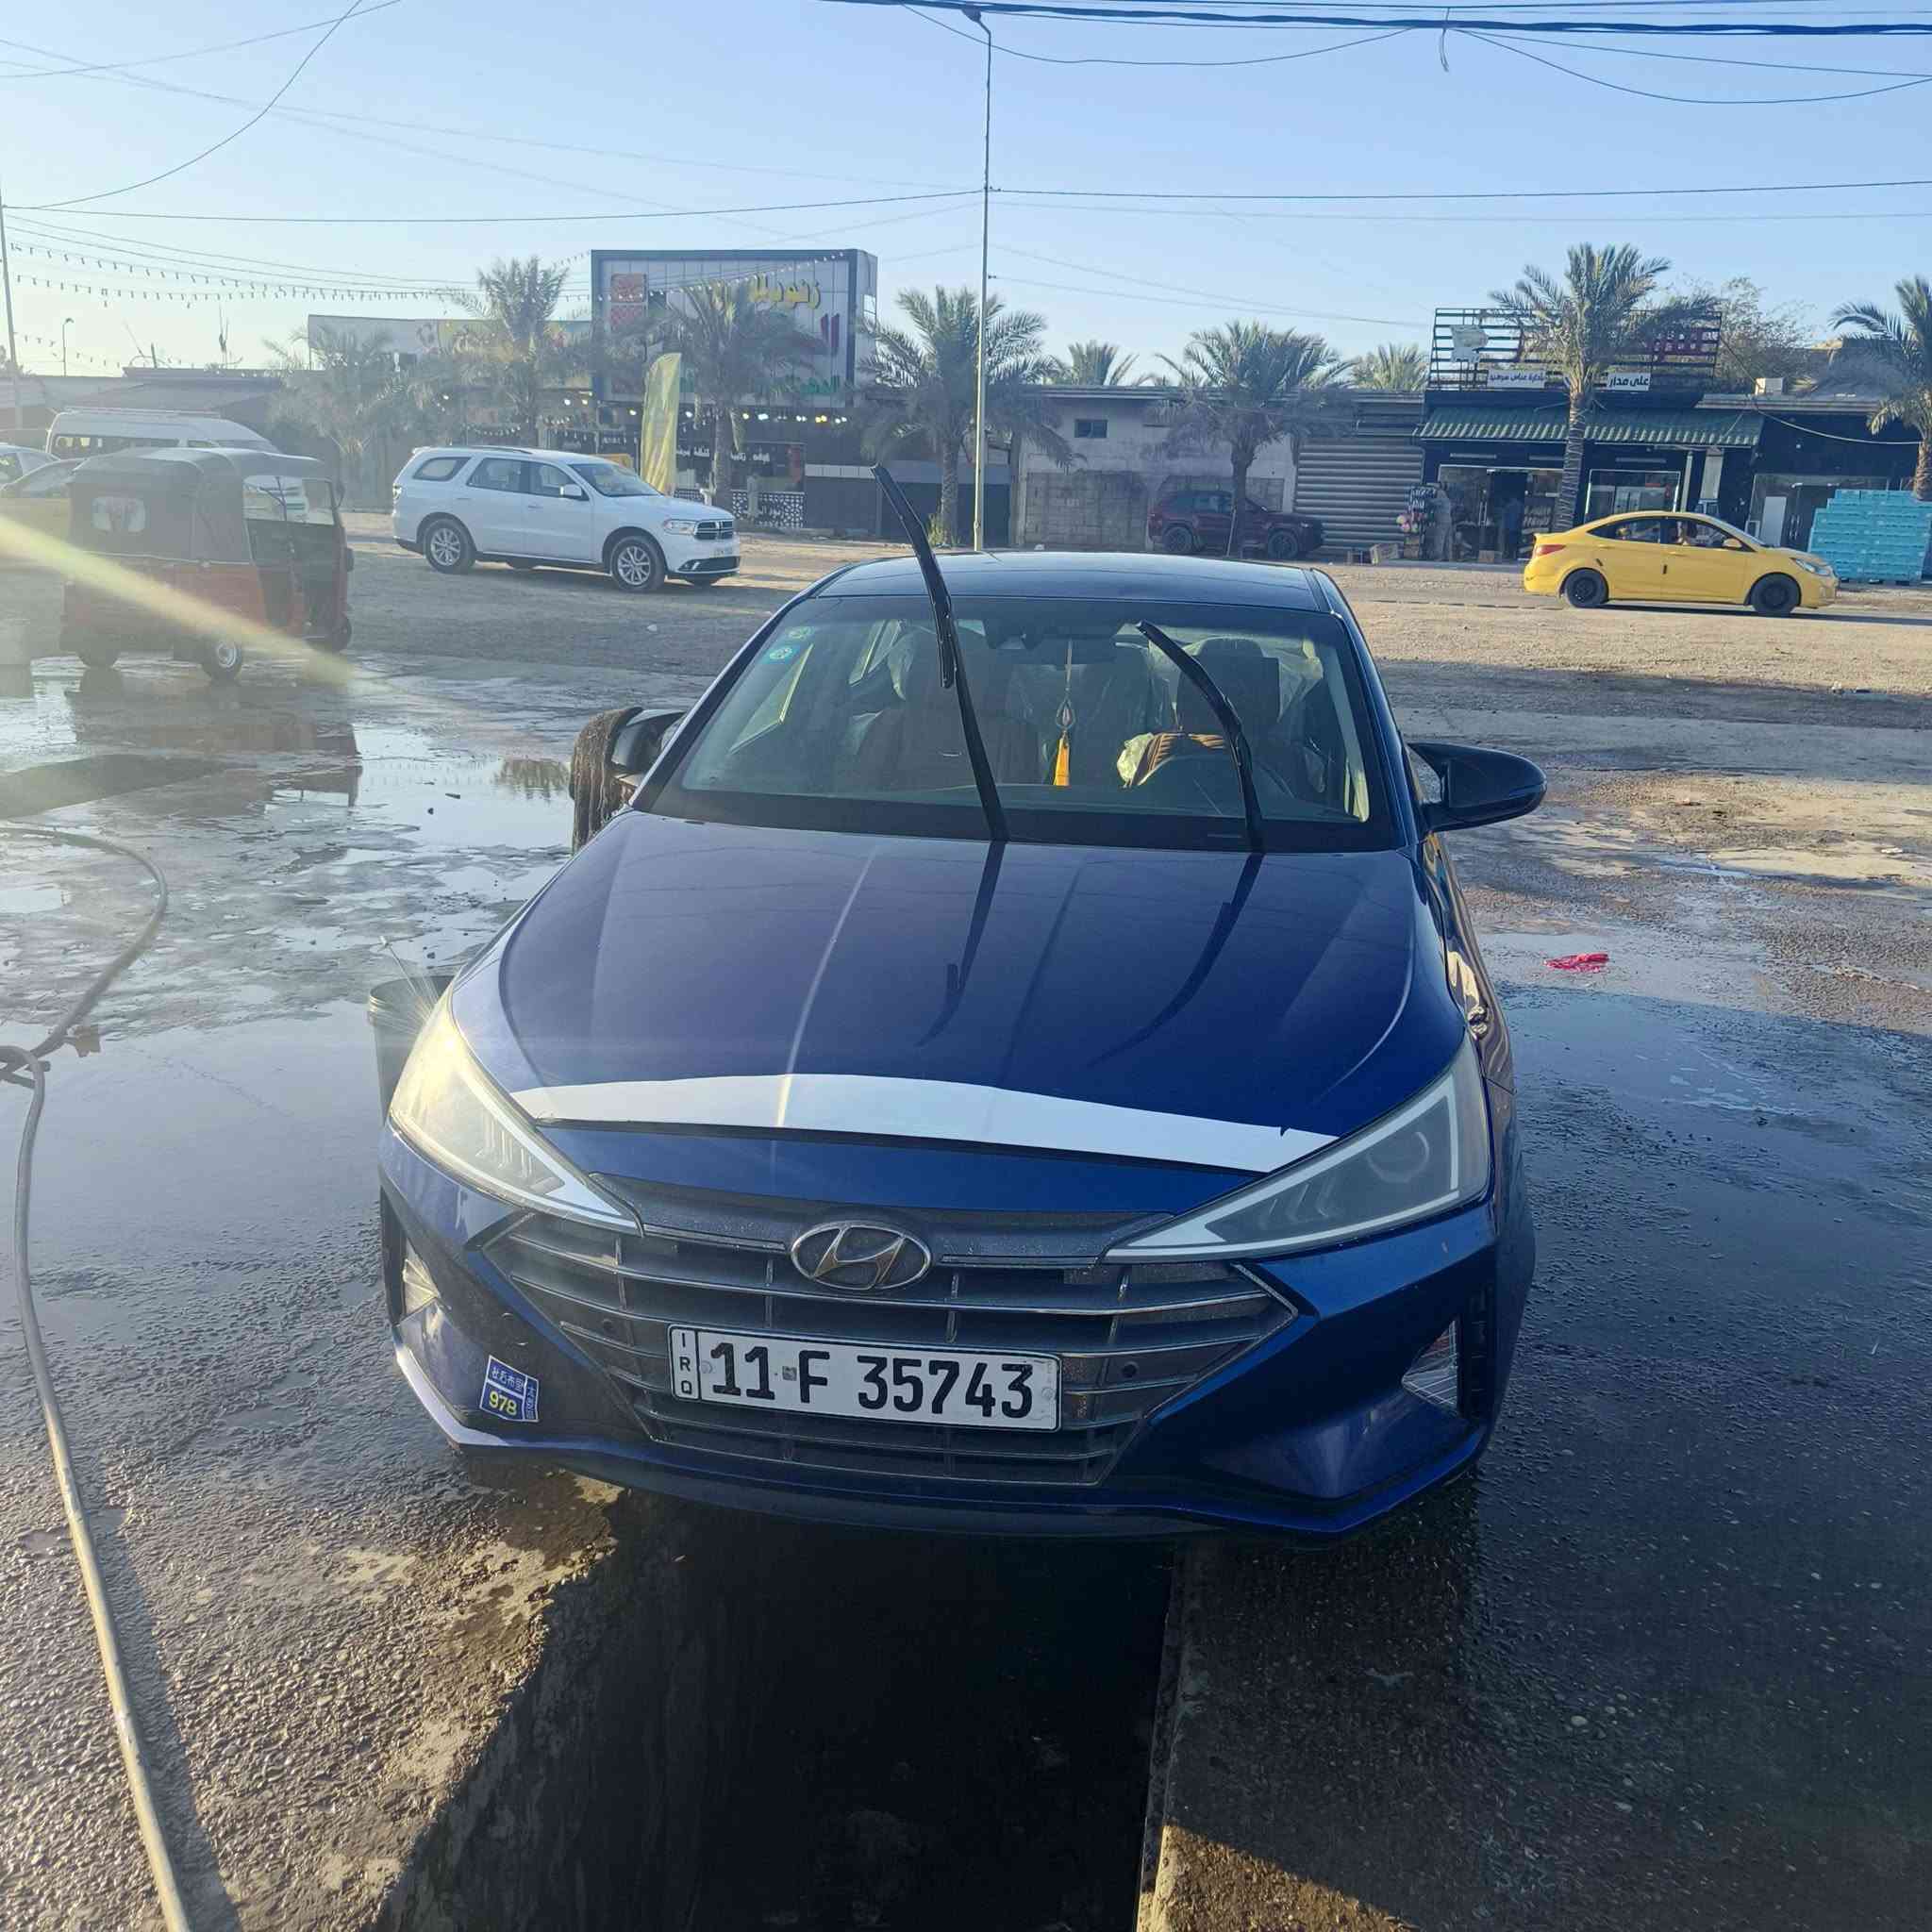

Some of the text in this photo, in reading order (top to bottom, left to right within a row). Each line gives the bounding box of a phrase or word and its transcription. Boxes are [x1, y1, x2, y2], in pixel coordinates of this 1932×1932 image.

[679, 1332, 692, 1395] IRQ
[710, 1341, 1034, 1419] 11 F 35743
[489, 1391, 517, 1416] 978
